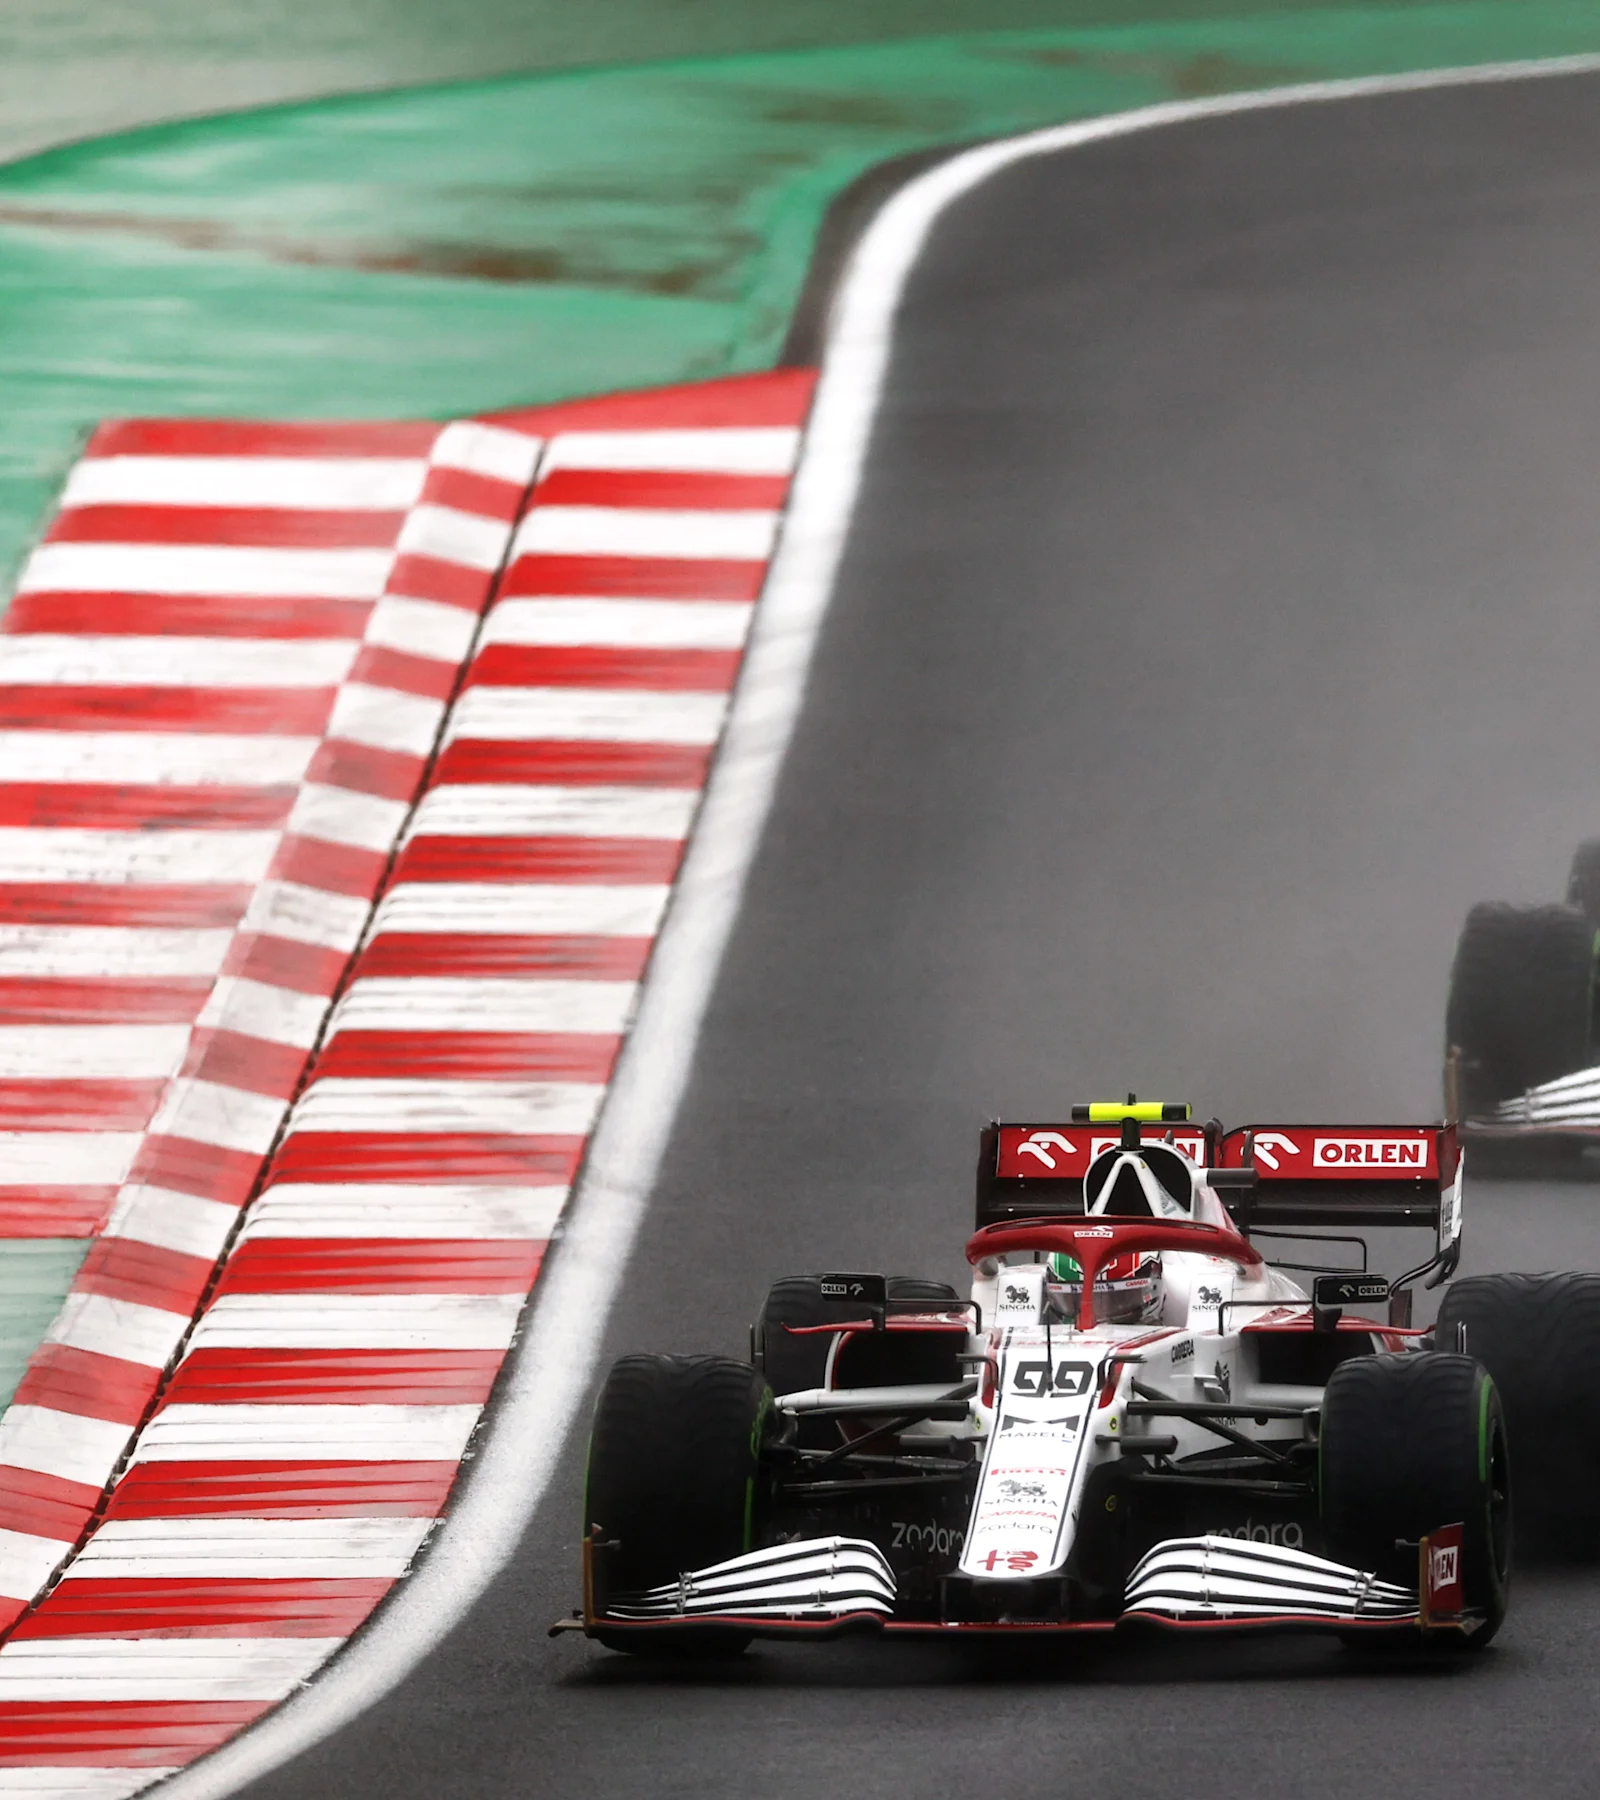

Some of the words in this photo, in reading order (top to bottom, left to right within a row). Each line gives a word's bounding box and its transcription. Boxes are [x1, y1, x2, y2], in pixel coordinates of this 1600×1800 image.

[1320, 1143, 1420, 1163] ORLEN
[1360, 1287, 1387, 1295] ORLEN
[1010, 1361, 1094, 1399] 99
